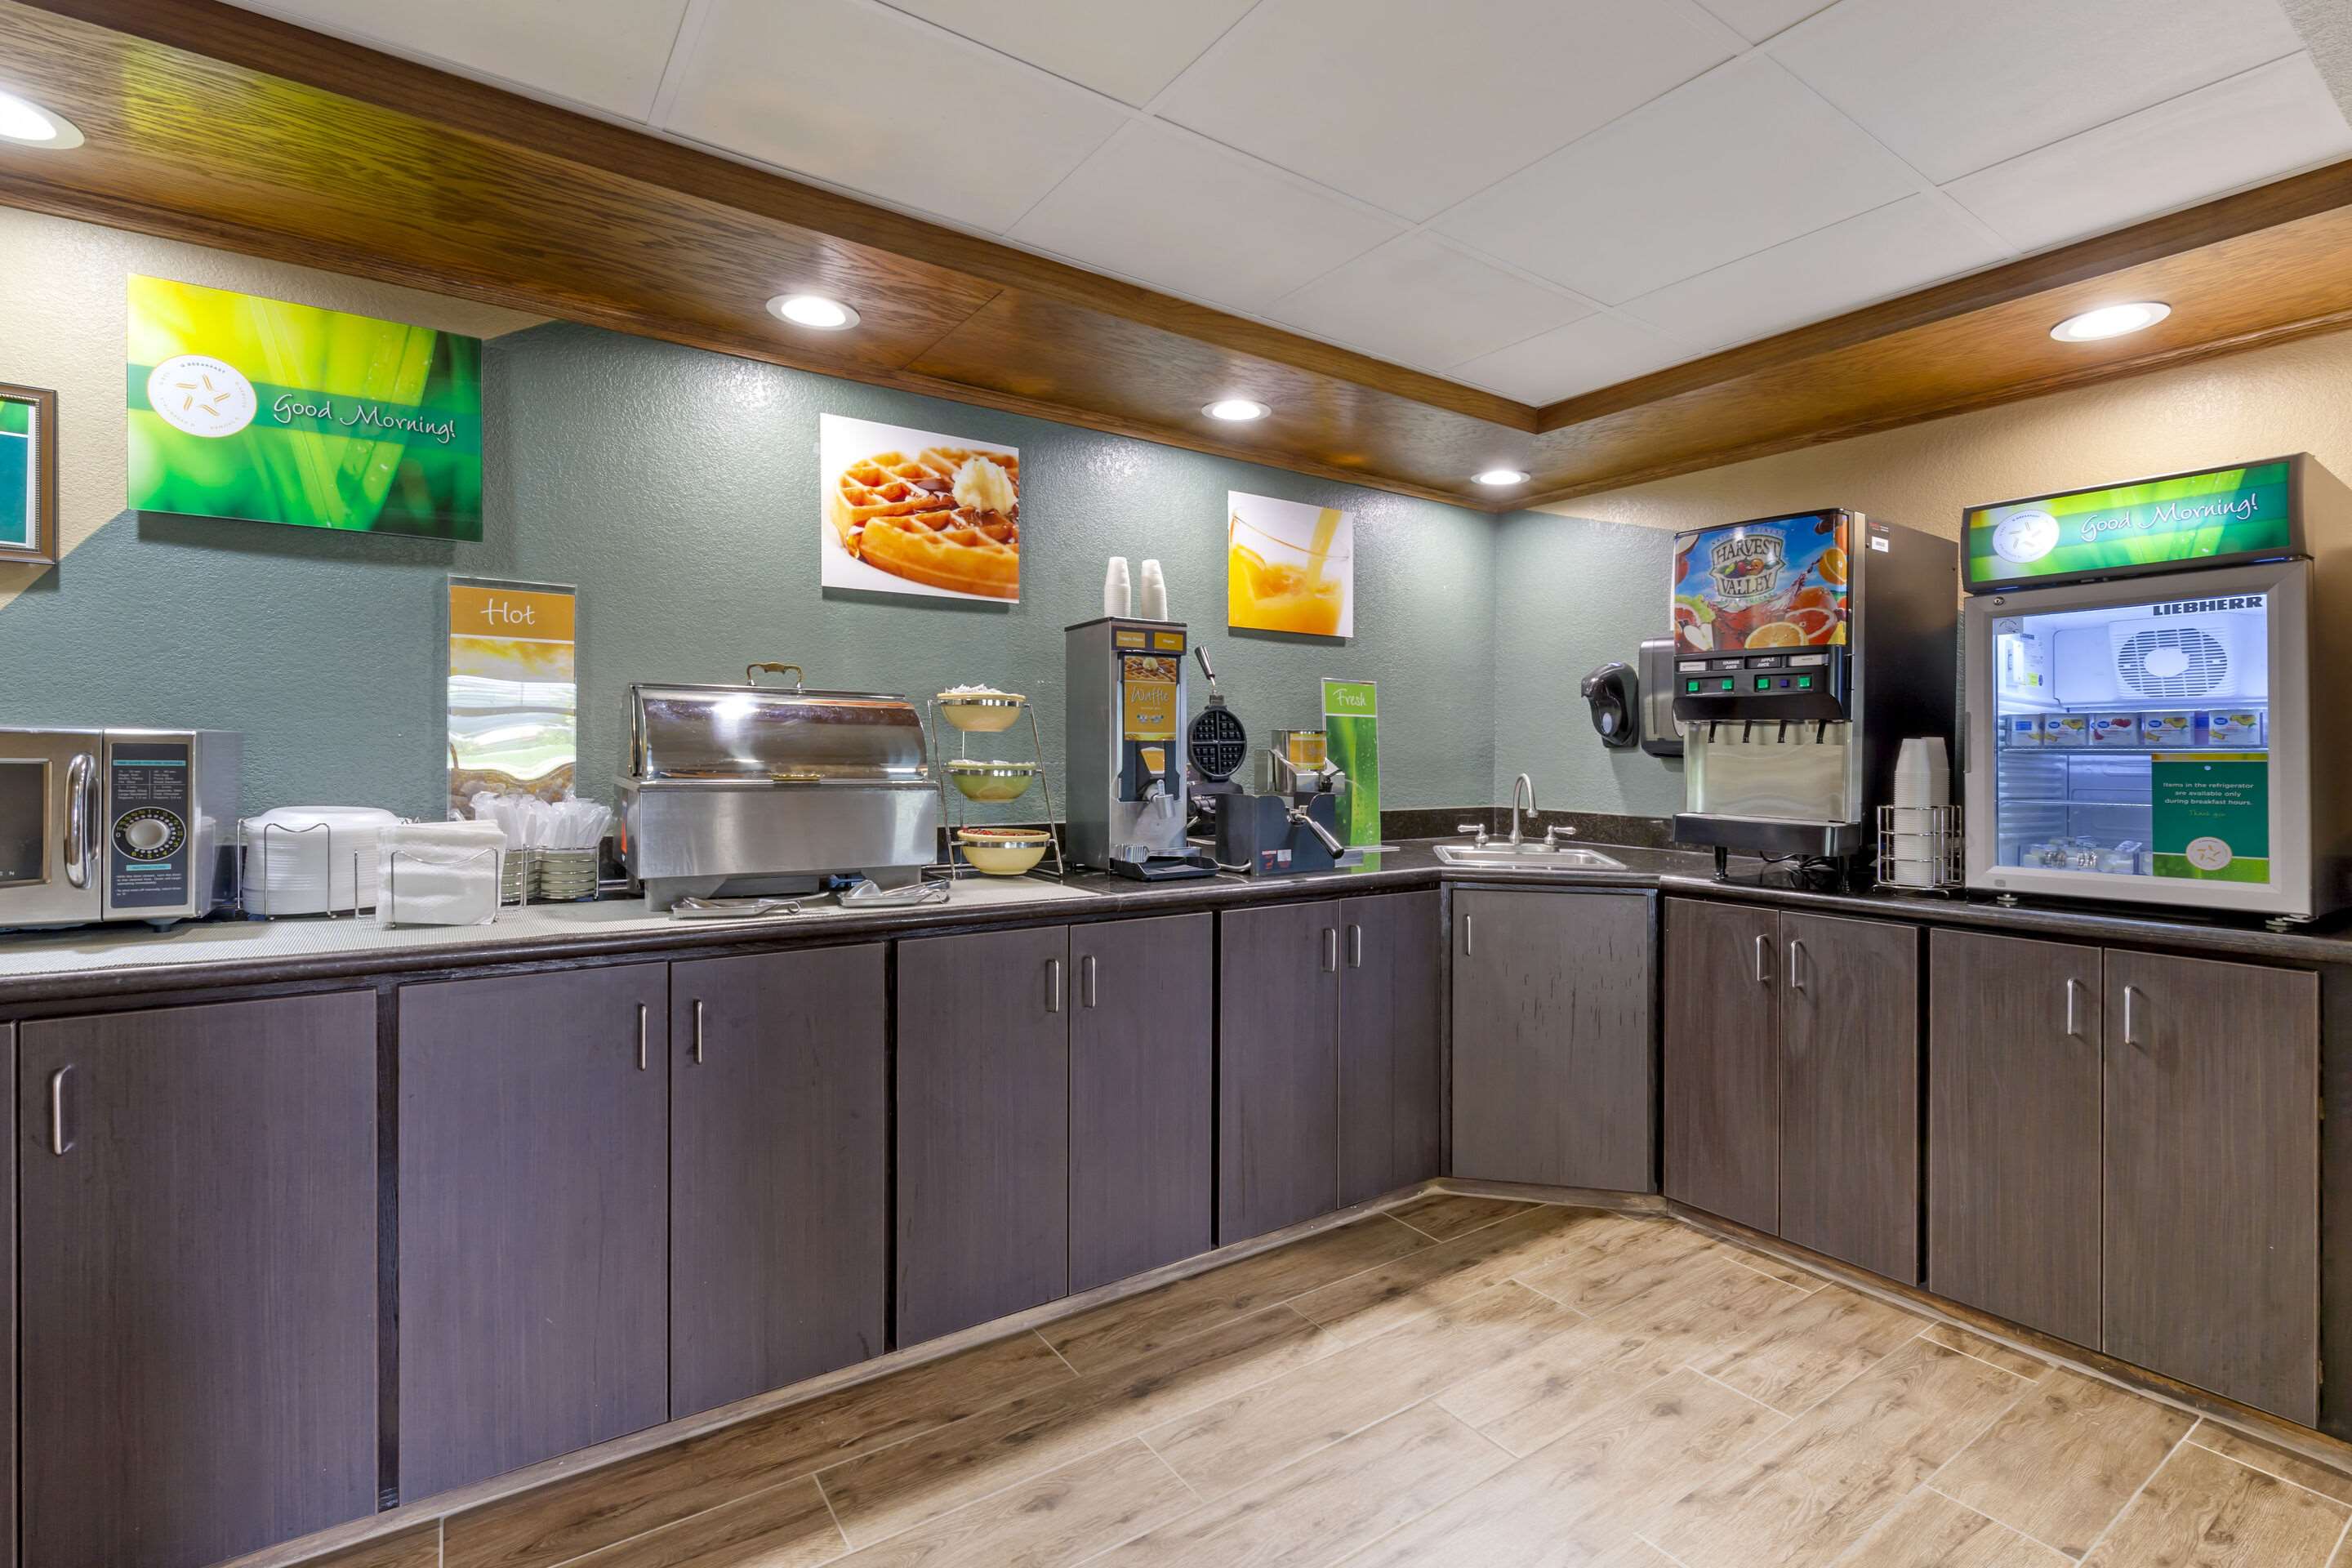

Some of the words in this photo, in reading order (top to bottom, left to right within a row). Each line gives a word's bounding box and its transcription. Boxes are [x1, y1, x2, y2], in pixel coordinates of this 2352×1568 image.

[274, 394, 332, 424] Good
[339, 404, 457, 443] Morning!
[2081, 509, 2132, 542] Good
[2138, 492, 2259, 528] Morning!
[1716, 538, 1780, 564] HARVEST
[1721, 572, 1772, 595] VALLEY
[480, 598, 535, 626] Hot
[2153, 596, 2263, 616] LIEBHERR
[1130, 686, 1170, 706] Waffle
[1332, 688, 1367, 706] Fresh
